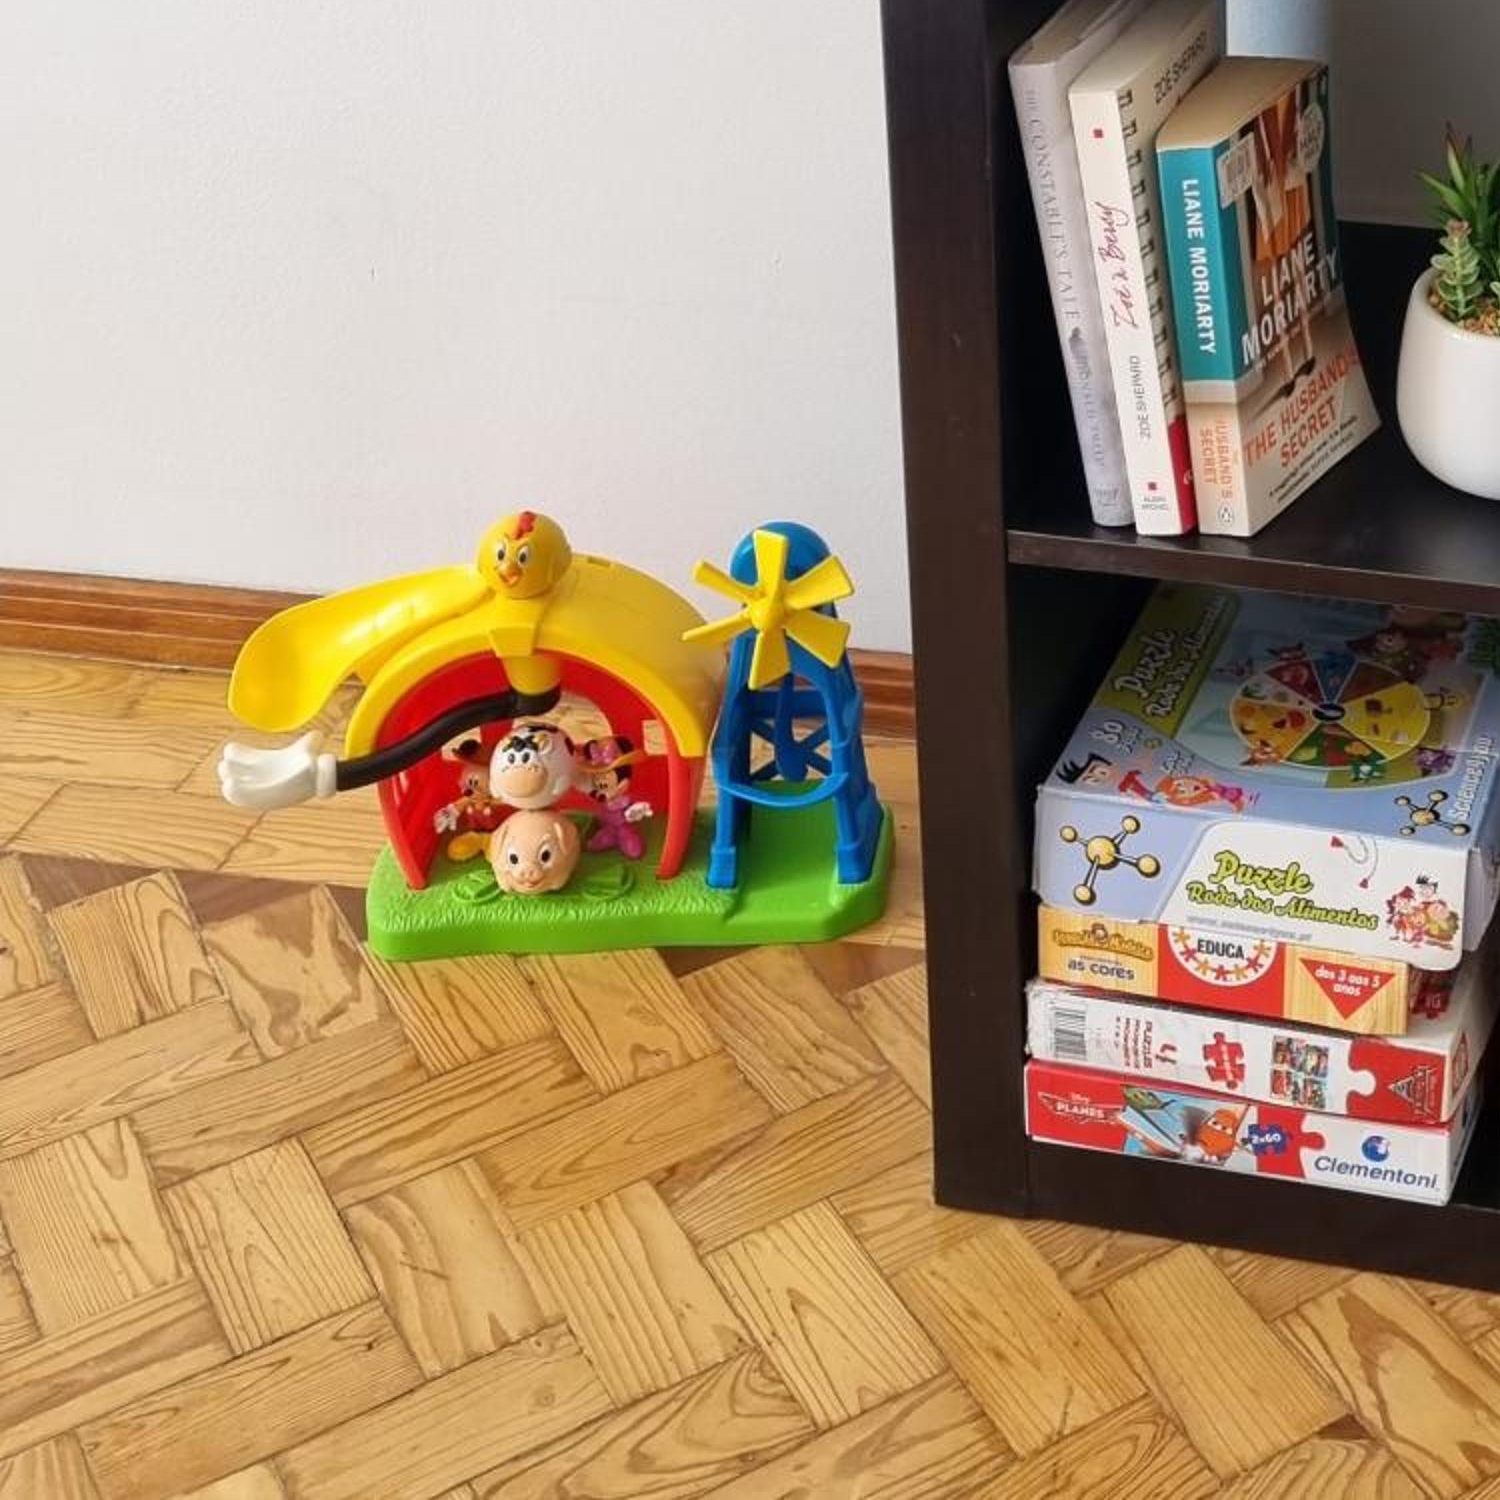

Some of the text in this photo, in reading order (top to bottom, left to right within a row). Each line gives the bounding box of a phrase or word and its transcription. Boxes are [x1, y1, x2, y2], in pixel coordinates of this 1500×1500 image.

[1182, 178, 1217, 355] LIANE MORIARTY
[1262, 232, 1315, 306] LIANE
[1241, 248, 1337, 366] MORIARTY
[1245, 421, 1277, 466] THE
[1280, 395, 1337, 468] SECRET
[1202, 426, 1218, 485] SECRET
[1113, 628, 1178, 699] Puzzle
[1208, 850, 1315, 896] Puzzle
[1186, 880, 1380, 931] Roda dos Alimentos
[1068, 959, 1085, 972] as
[1090, 962, 1135, 981] cores
[1197, 937, 1245, 960] EDUCA
[1315, 965, 1381, 988] dos 3 aos 5
[1333, 981, 1362, 997] anos
[1056, 1101, 1105, 1119] PLANES
[1314, 1155, 1439, 1189] Clementoni
